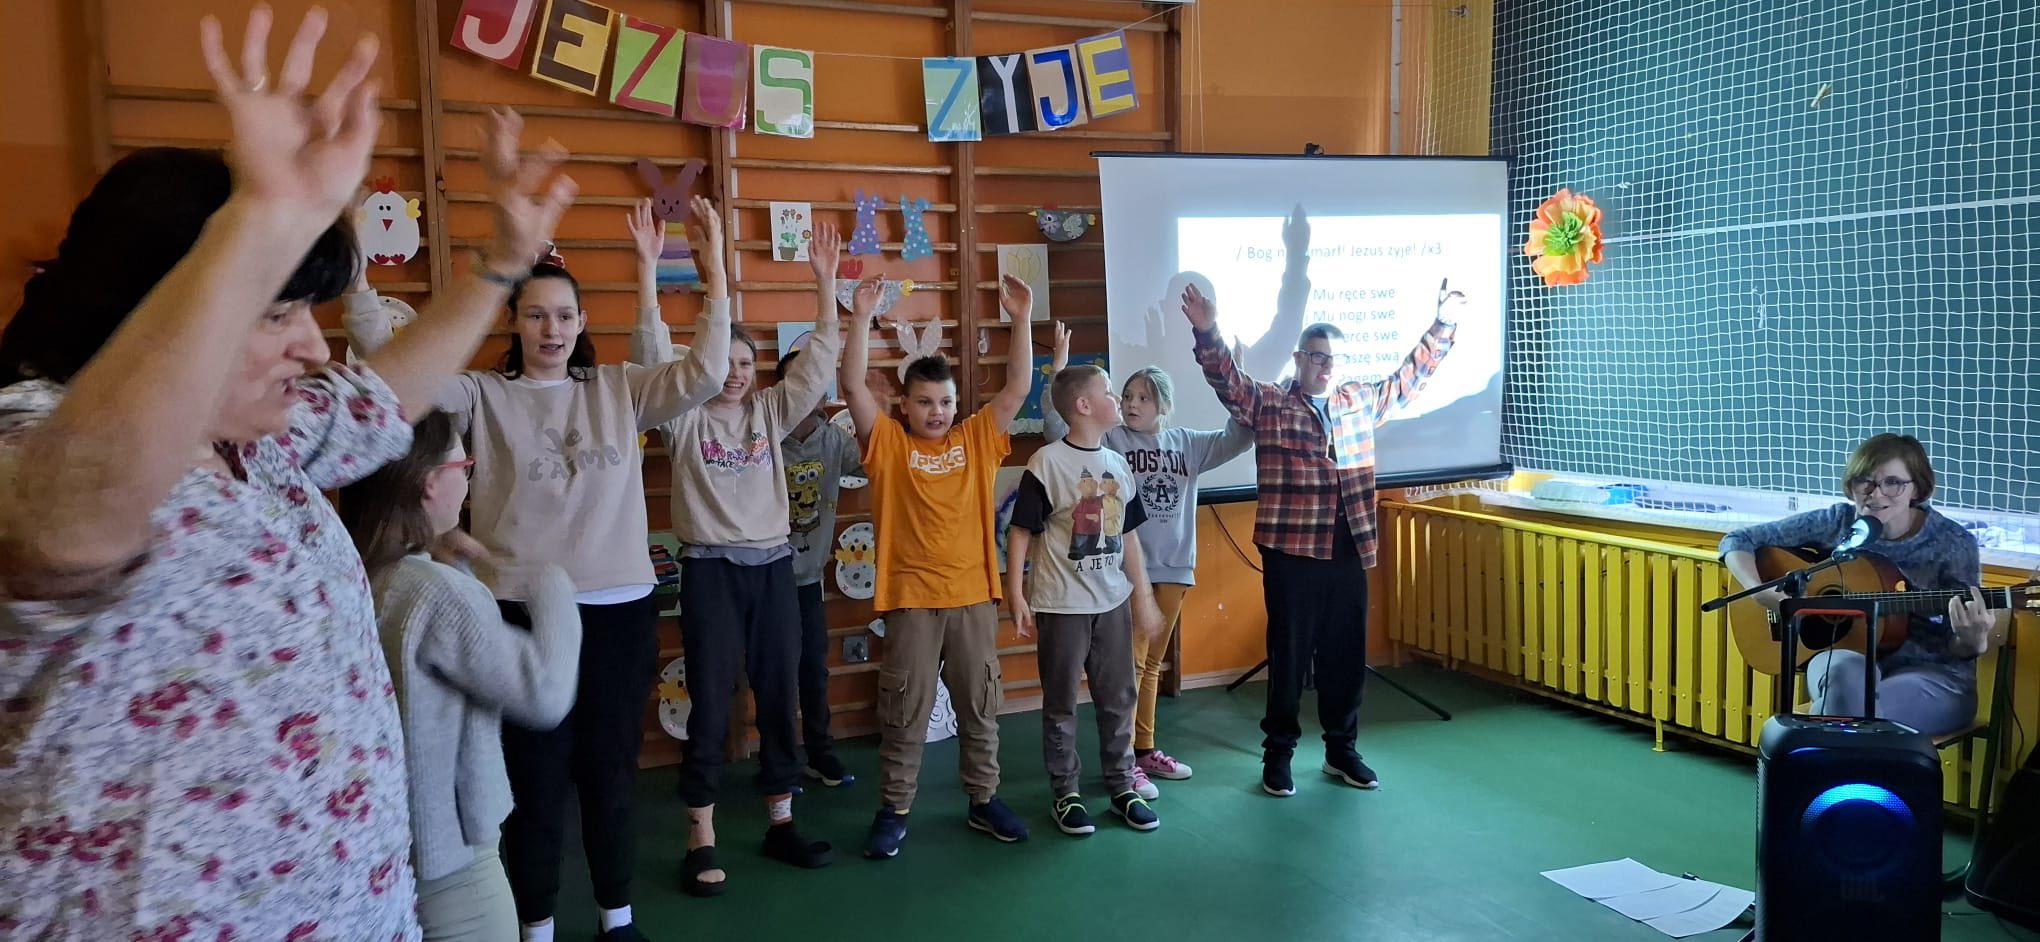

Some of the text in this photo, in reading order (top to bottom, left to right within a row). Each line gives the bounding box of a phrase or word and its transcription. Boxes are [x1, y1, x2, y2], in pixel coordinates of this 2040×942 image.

[461, 0, 812, 133] JEZUS
[1350, 245, 1383, 257] Jezus
[1313, 288, 1396, 302] Mu ręce swe
[1313, 309, 1396, 323] Mu nogi swe
[1343, 330, 1399, 343] erce swe
[544, 427, 583, 455] Je
[1125, 448, 1189, 477] BOSTON
[1155, 484, 1171, 503] A
[1075, 555, 1114, 573] A JE TO
